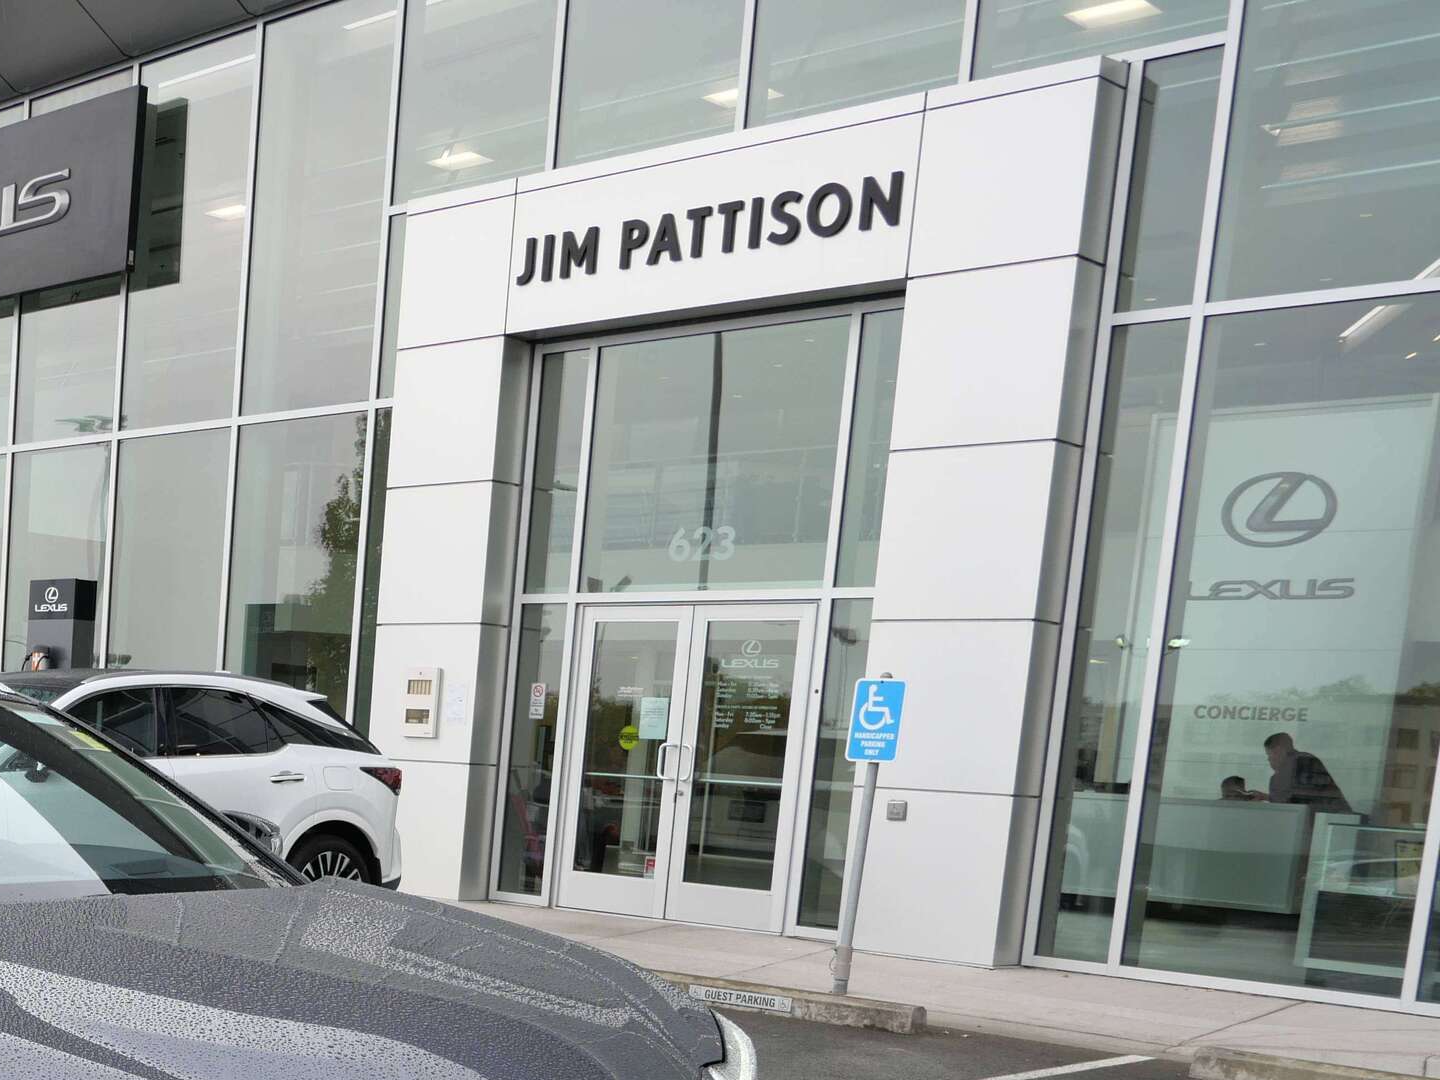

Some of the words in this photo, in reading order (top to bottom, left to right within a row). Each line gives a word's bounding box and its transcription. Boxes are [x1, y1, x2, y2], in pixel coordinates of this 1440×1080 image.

[516, 226, 600, 286] JIM
[619, 171, 905, 270] PATTISON
[668, 526, 736, 561] 623
[34, 603, 68, 612] LEXUS
[721, 658, 779, 669] LEXUS
[1193, 704, 1309, 722] CONCIERGE
[854, 731, 895, 740] HANDICAPPED
[860, 740, 886, 748] PARKING
[863, 748, 880, 756] ONLY
[704, 989, 734, 1001] GUEST
[736, 993, 776, 1008] PARKING
